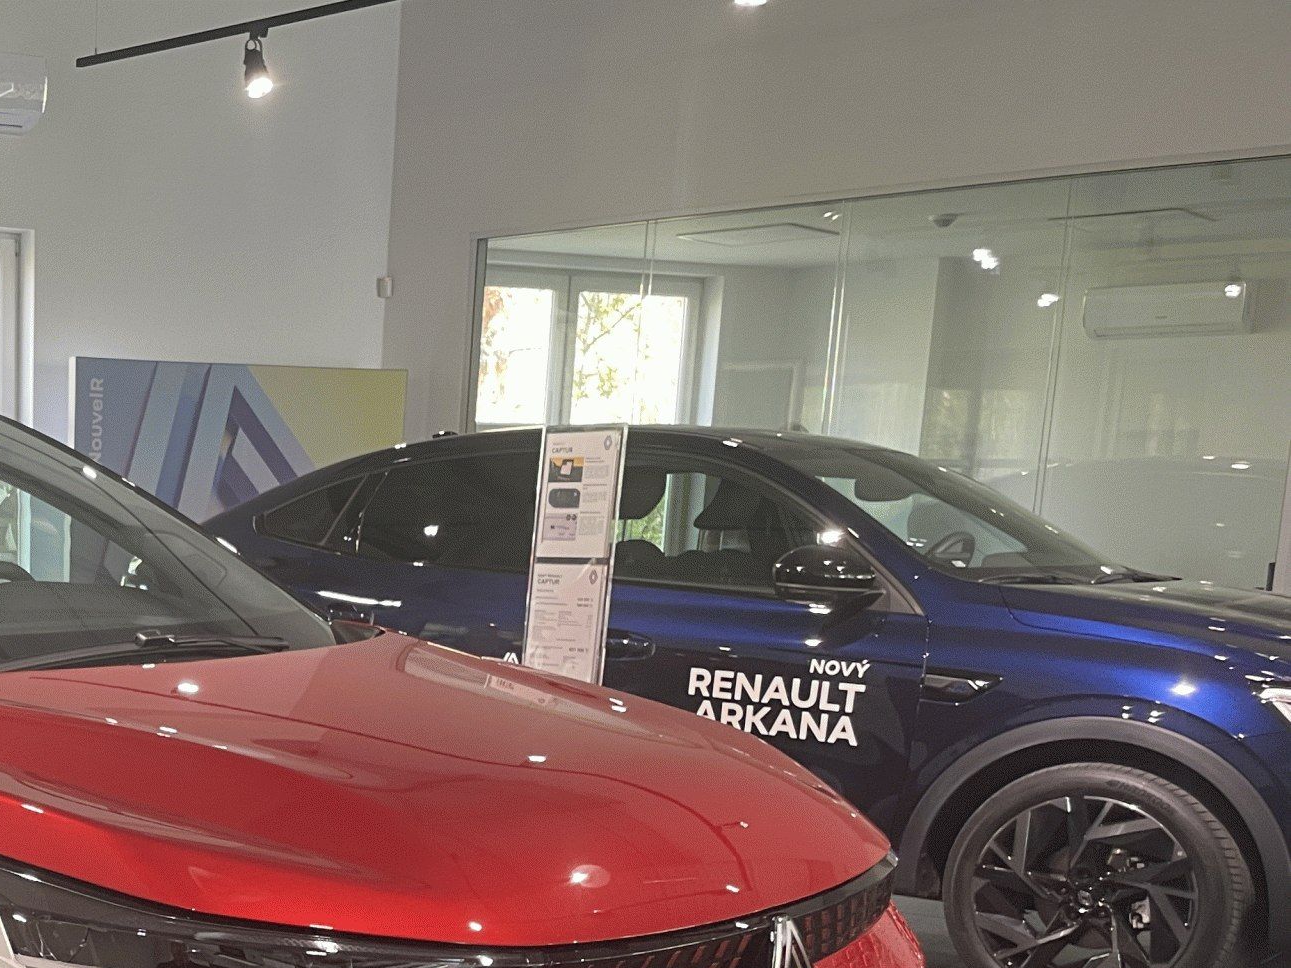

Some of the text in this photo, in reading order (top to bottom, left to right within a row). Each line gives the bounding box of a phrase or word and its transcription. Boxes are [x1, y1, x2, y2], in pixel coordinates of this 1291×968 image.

[688, 667, 866, 713] RENAULT
[809, 658, 870, 678] NOVÝ
[696, 700, 858, 746] ARKANA
